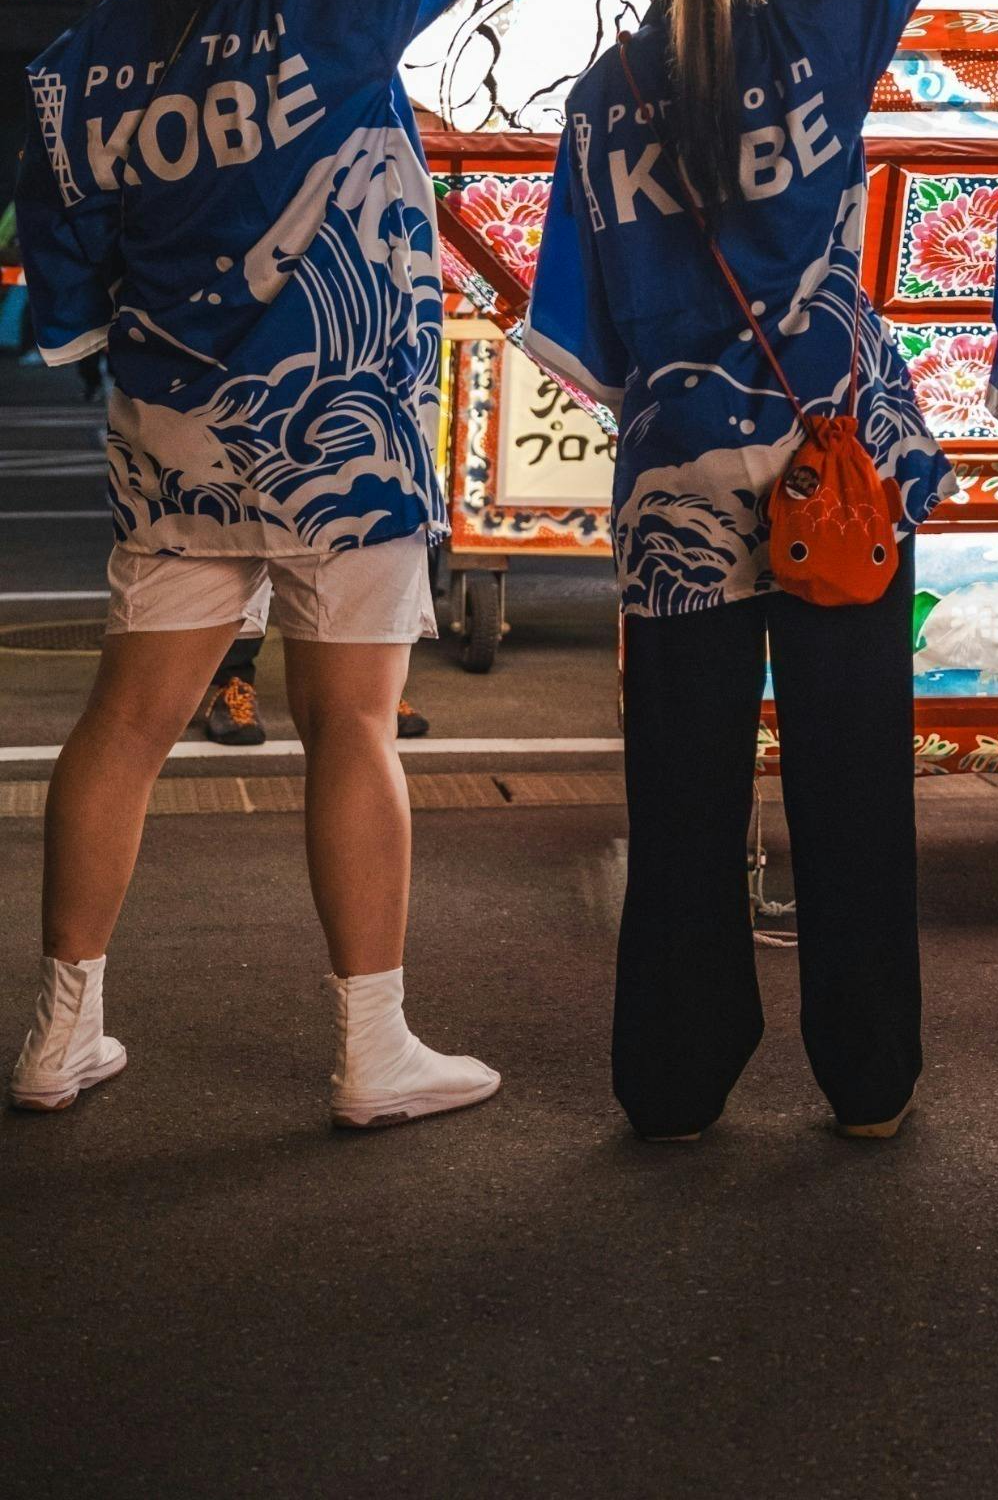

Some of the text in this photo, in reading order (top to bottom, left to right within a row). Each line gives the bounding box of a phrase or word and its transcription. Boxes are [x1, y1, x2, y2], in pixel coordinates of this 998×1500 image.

[84, 60, 163, 97] Por
[84, 53, 327, 191] KOBE
[607, 99, 672, 134] Por
